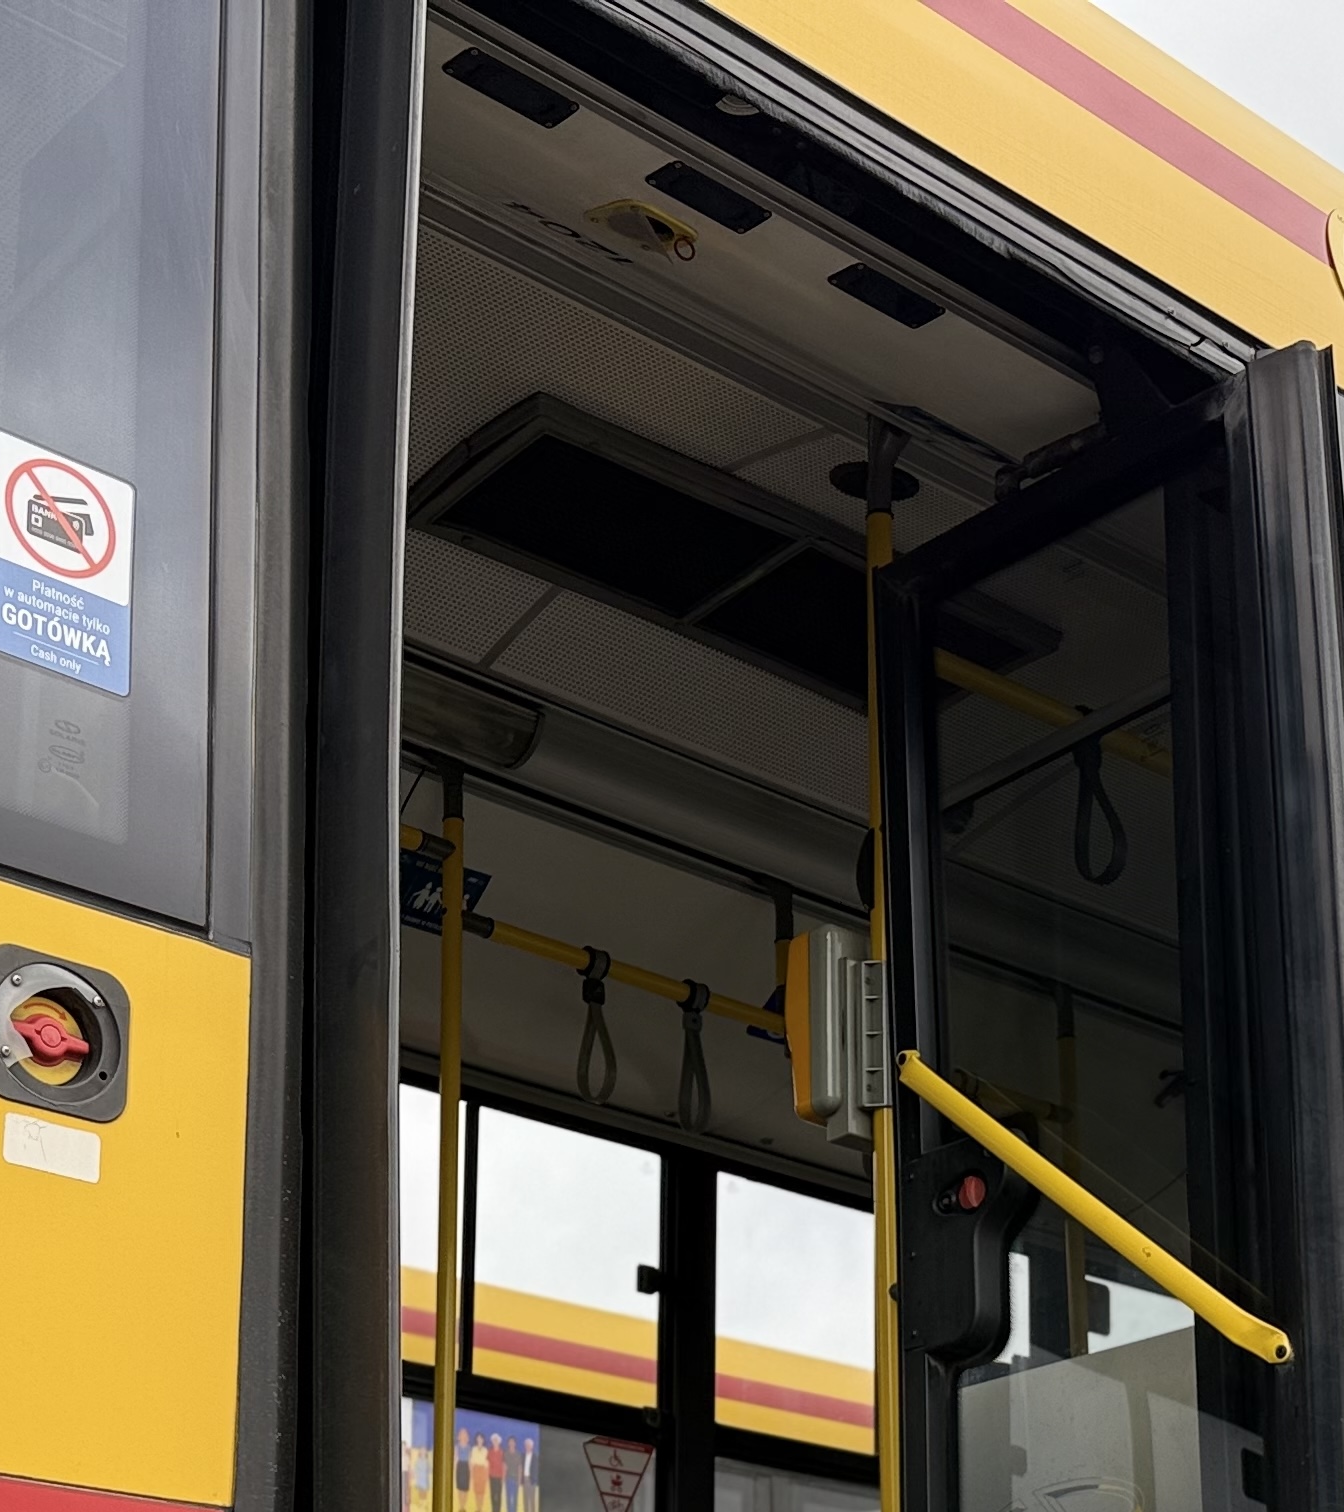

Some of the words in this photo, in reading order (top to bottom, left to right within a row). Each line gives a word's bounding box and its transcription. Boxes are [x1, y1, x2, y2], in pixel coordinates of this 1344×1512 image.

[4, 587, 14, 598] w
[17, 592, 79, 622] automacie
[82, 614, 110, 634] tylko
[32, 579, 85, 610] Płatność
[1, 603, 111, 666] GOTÓWKĄ
[30, 645, 57, 664] Cash
[59, 655, 81, 675] only
